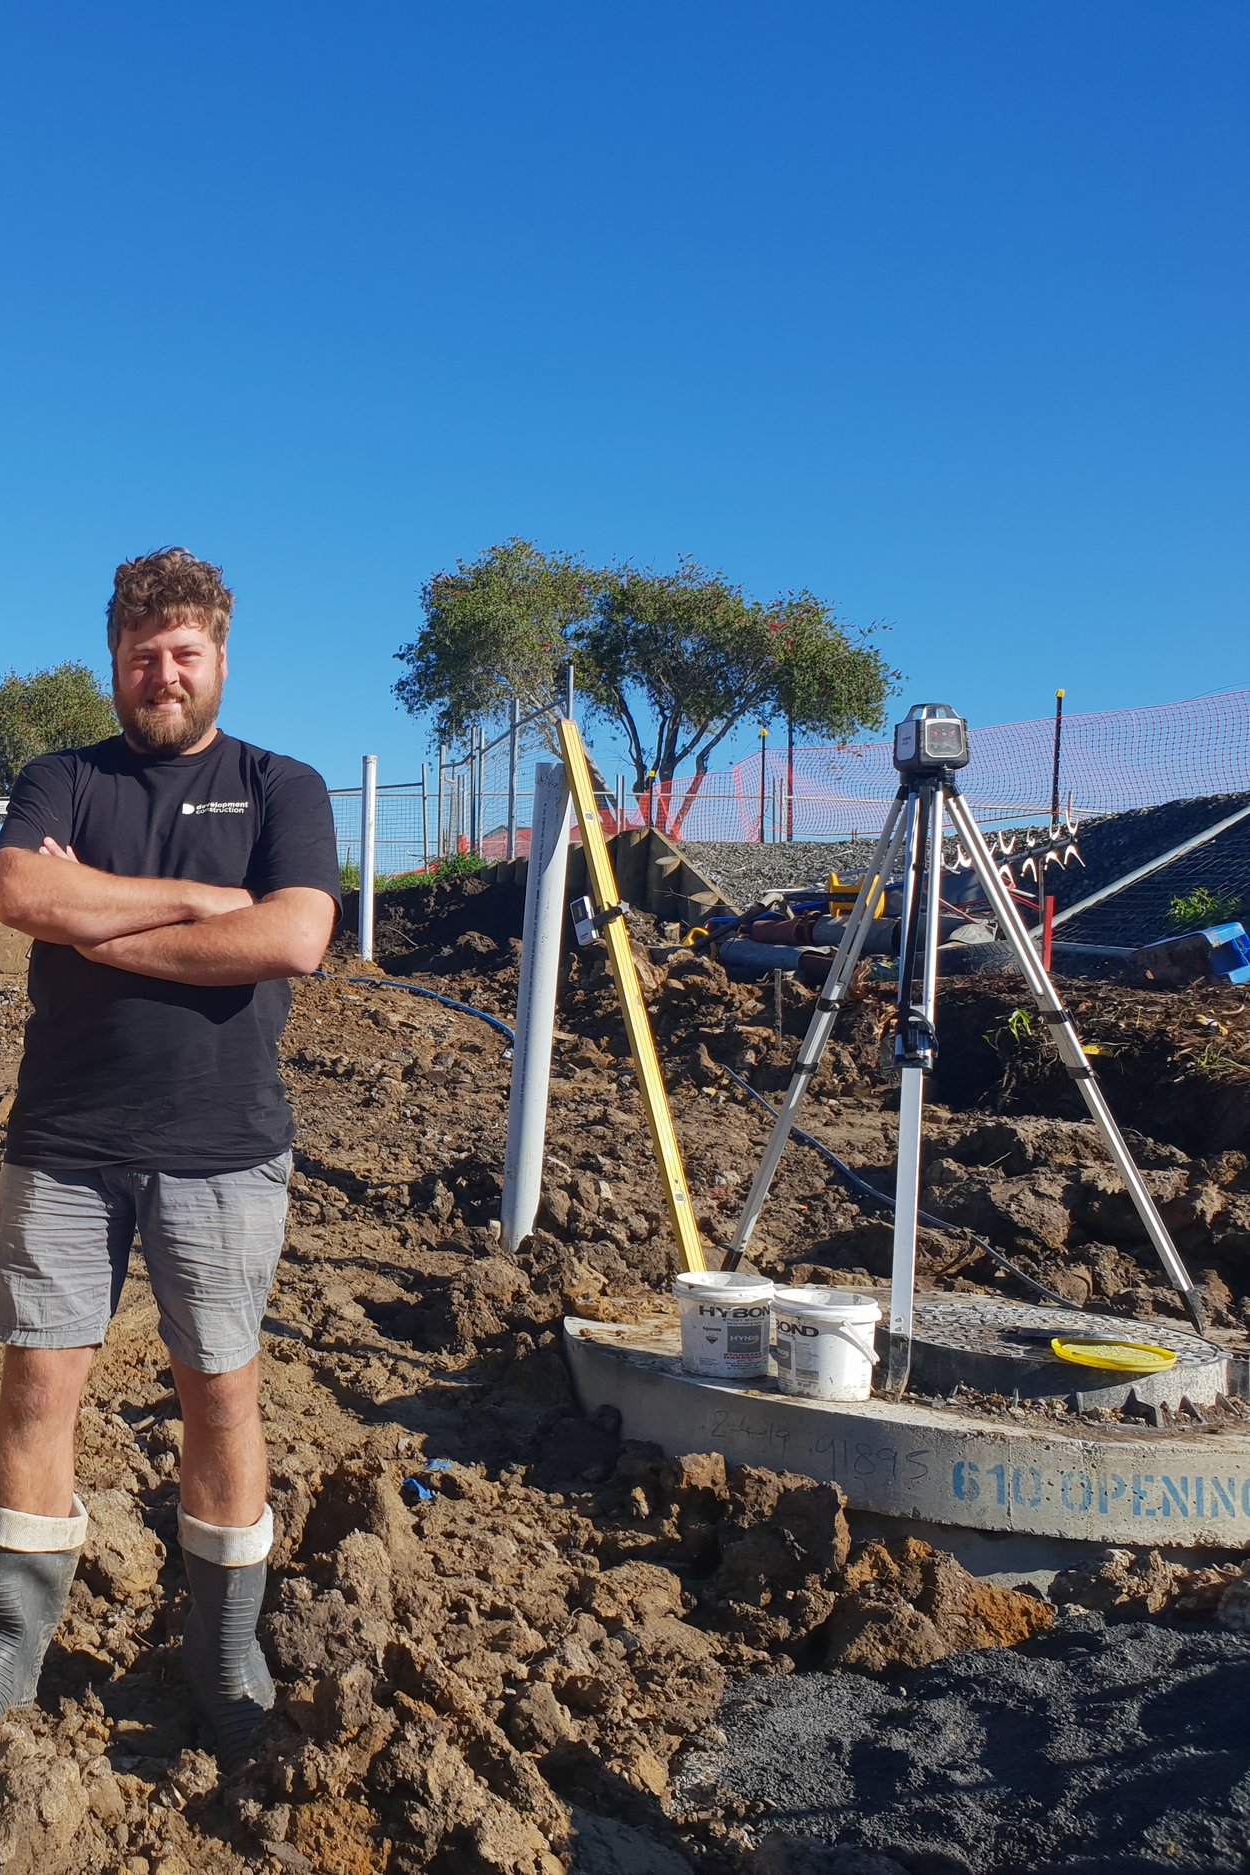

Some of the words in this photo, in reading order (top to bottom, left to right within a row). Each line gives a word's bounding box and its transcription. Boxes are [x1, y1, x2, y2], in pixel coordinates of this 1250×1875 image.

[196, 801, 249, 810] development
[195, 807, 245, 815] construction
[952, 1460, 1042, 1508] 610
